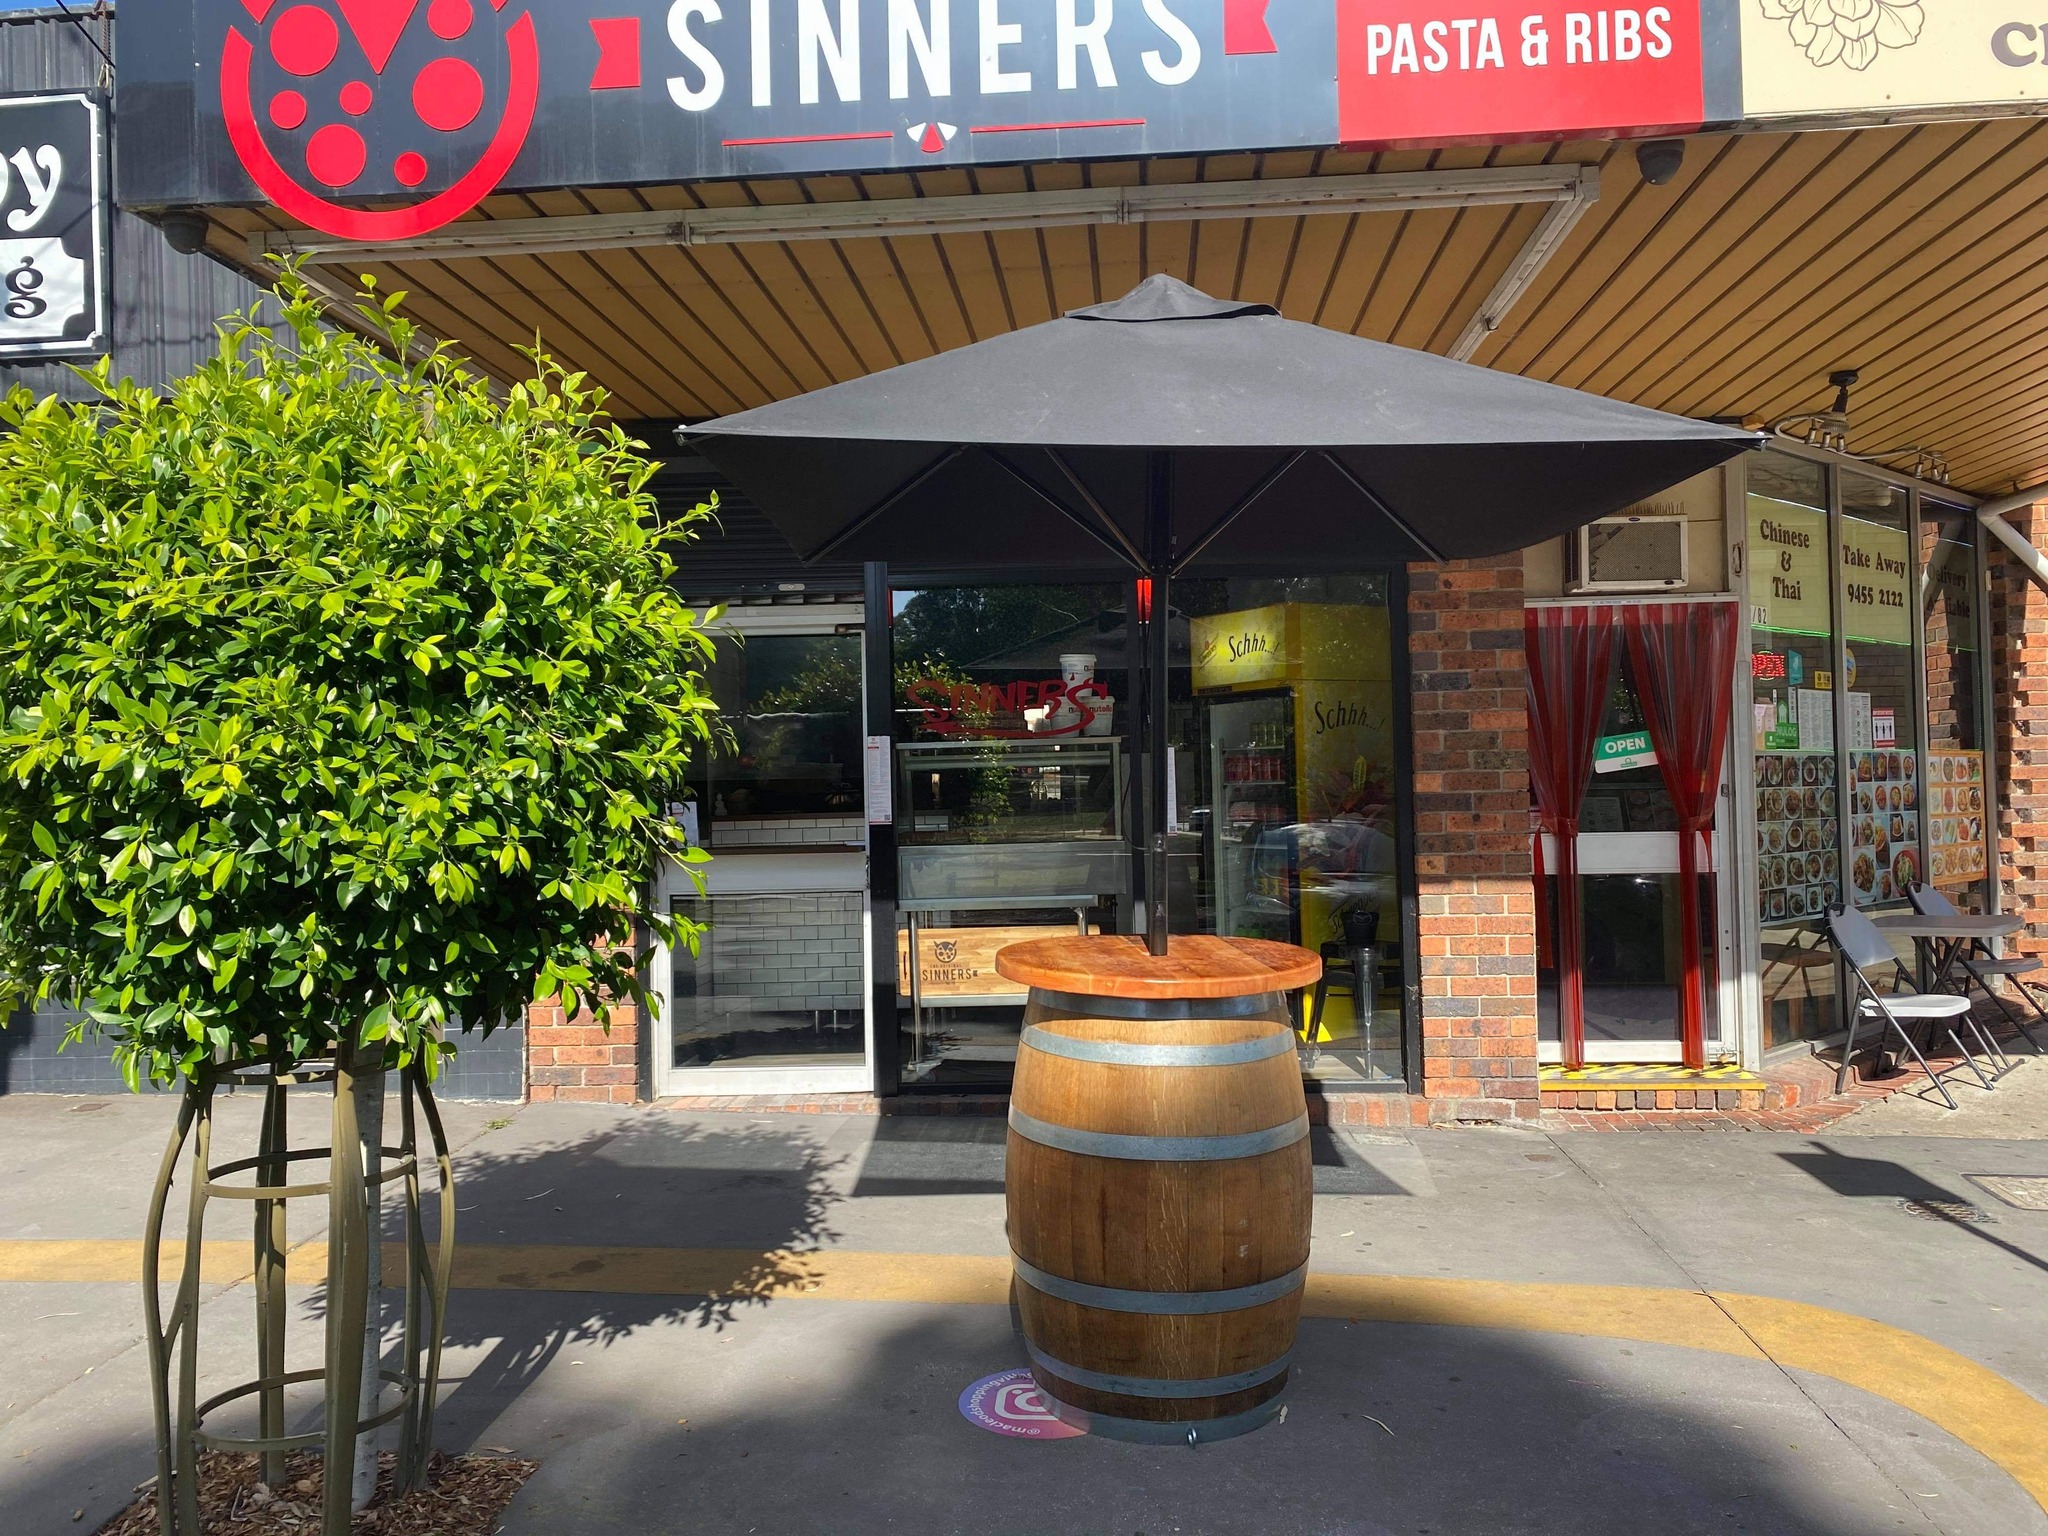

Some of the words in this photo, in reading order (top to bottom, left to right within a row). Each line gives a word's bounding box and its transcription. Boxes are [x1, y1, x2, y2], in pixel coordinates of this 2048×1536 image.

[1367, 18, 1504, 74] PASTA
[1522, 15, 1548, 66] &
[1566, 7, 1672, 63] RIBS
[666, 0, 1201, 111] SINNERS
[0, 144, 61, 232] y
[1760, 519, 1810, 548] Chinese
[1781, 551, 1792, 572] &
[1842, 545, 1871, 569] Take
[1875, 552, 1906, 579] Away
[1773, 576, 1802, 601] Thai
[1847, 584, 1874, 605] 9455
[1879, 591, 1904, 608] 2122
[906, 676, 1108, 738] SINNERS
[1604, 736, 1646, 754] OPEN
[922, 968, 972, 981] SINNERS
